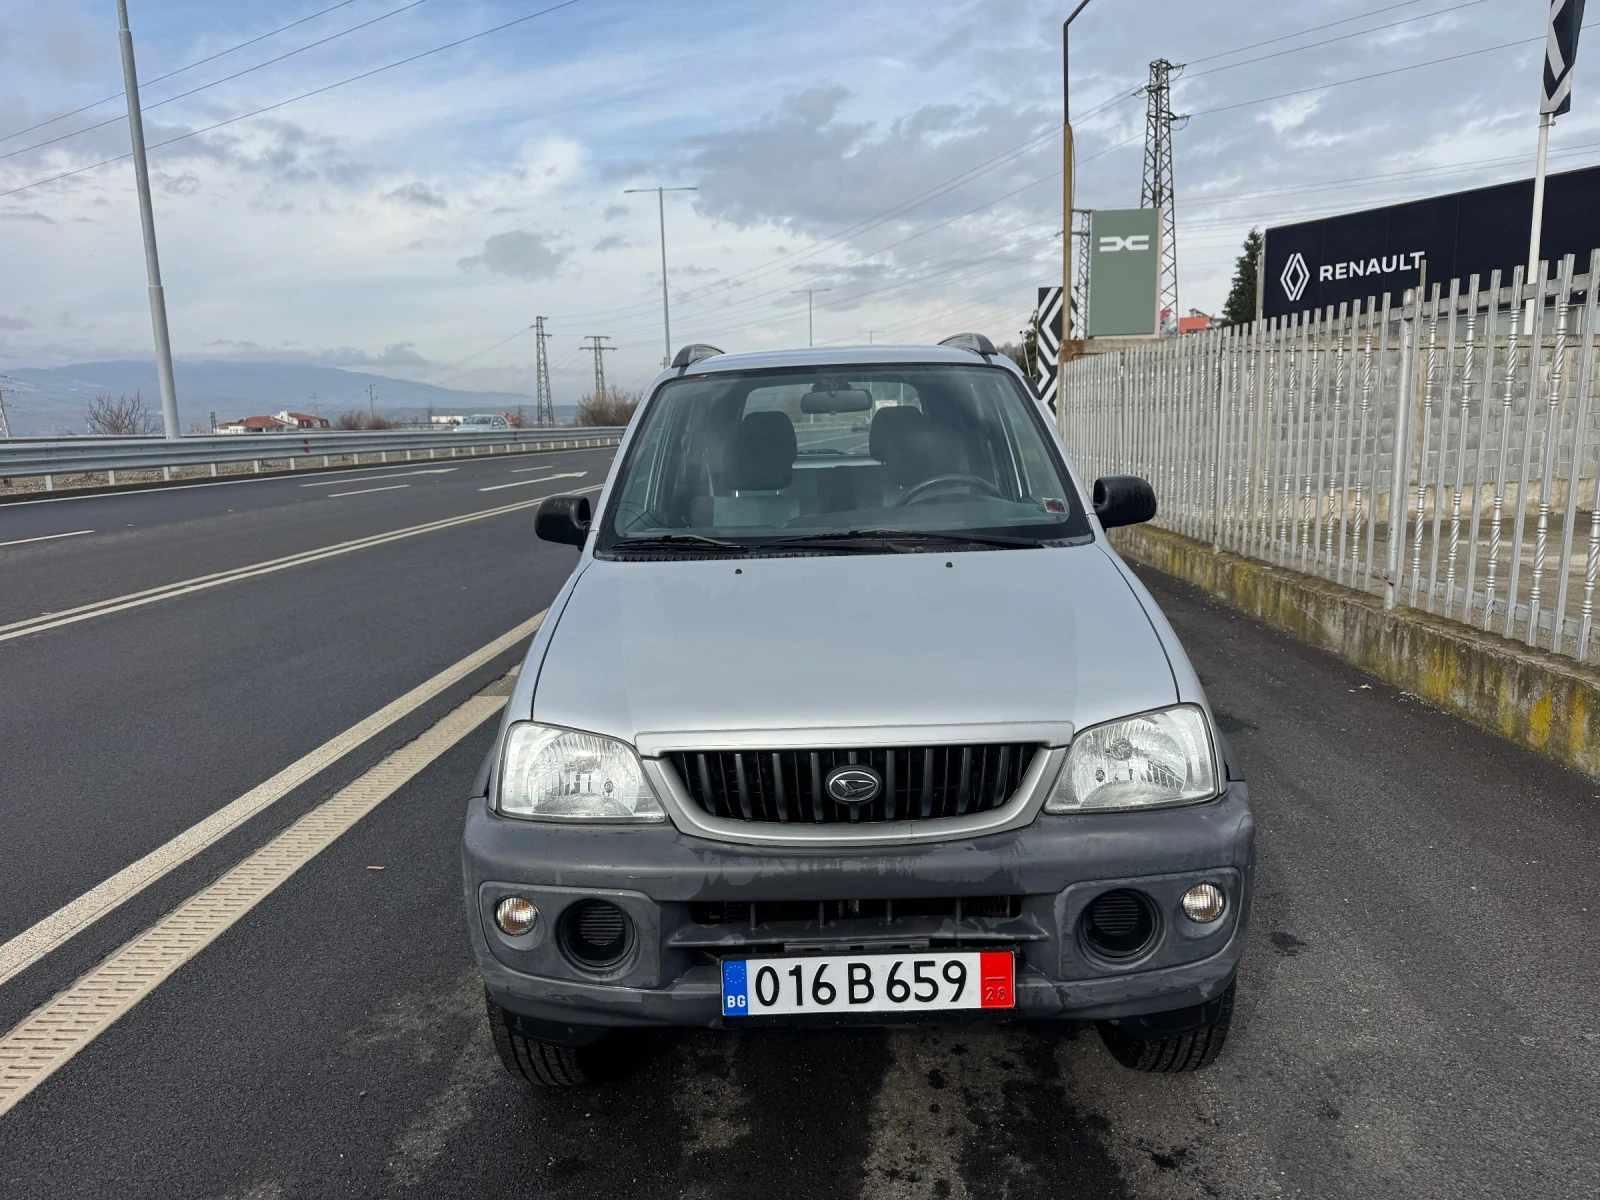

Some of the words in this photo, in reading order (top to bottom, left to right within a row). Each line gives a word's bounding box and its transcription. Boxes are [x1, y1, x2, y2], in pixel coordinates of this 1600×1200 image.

[1319, 251, 1425, 282] RENAULT
[985, 986, 1007, 1001] 28
[727, 995, 746, 1008] BG
